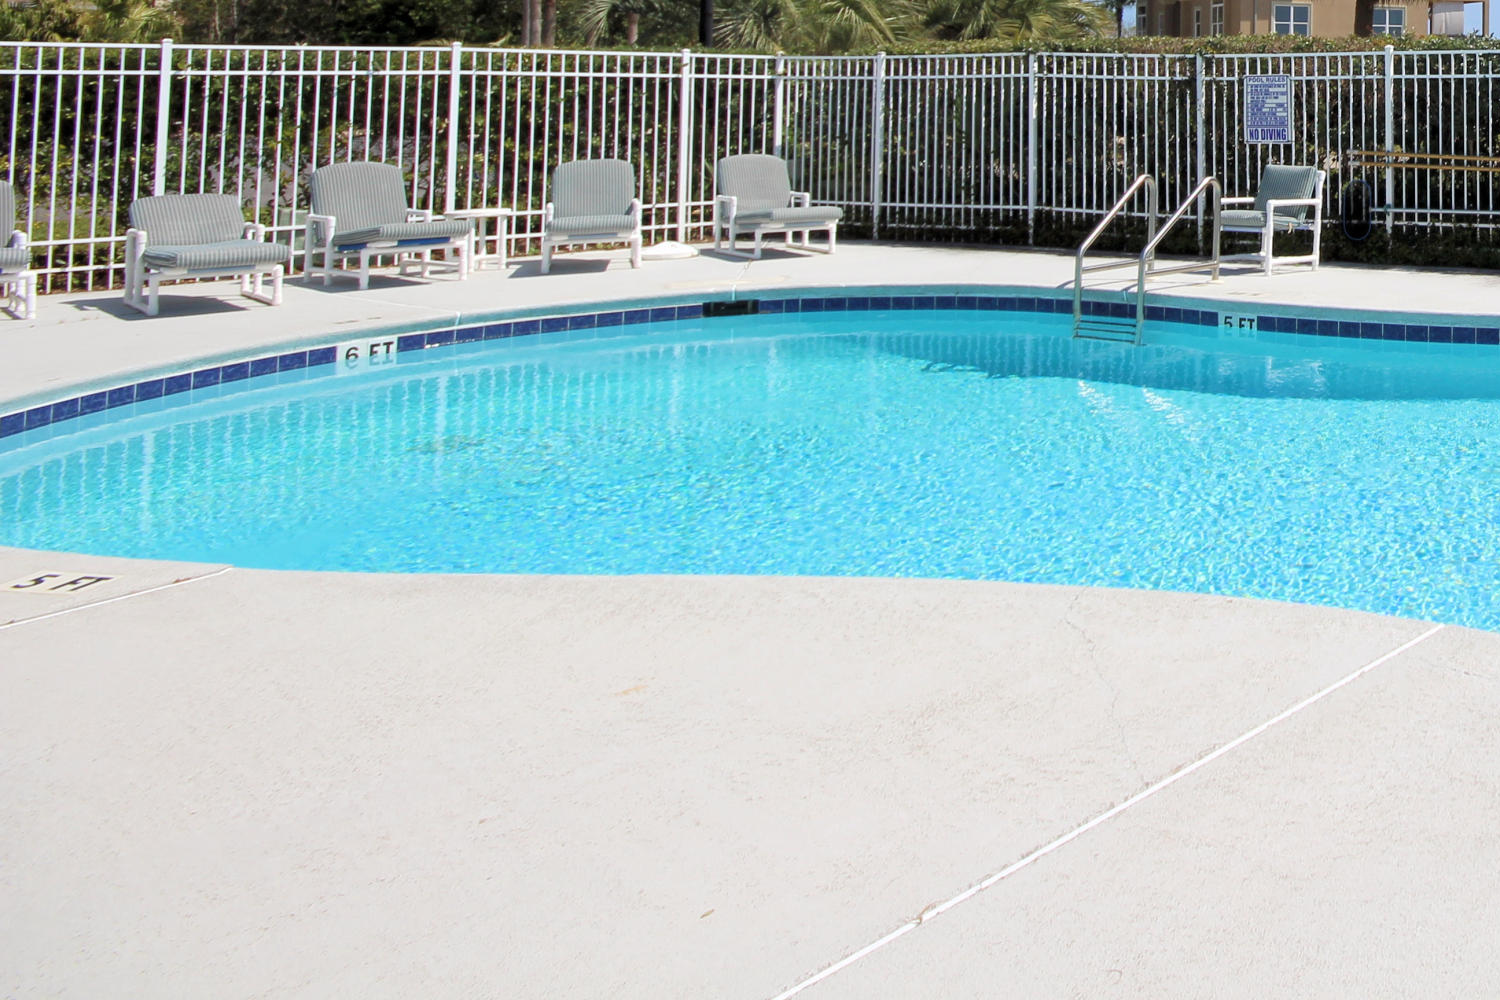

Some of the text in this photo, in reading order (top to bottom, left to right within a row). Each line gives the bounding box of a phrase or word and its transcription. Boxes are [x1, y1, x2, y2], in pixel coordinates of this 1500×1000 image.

[1249, 128, 1287, 140] NO DIVING
[1224, 315, 1255, 330] 5 FT
[345, 341, 394, 361] 6 FT
[11, 573, 114, 592] 5 FT
